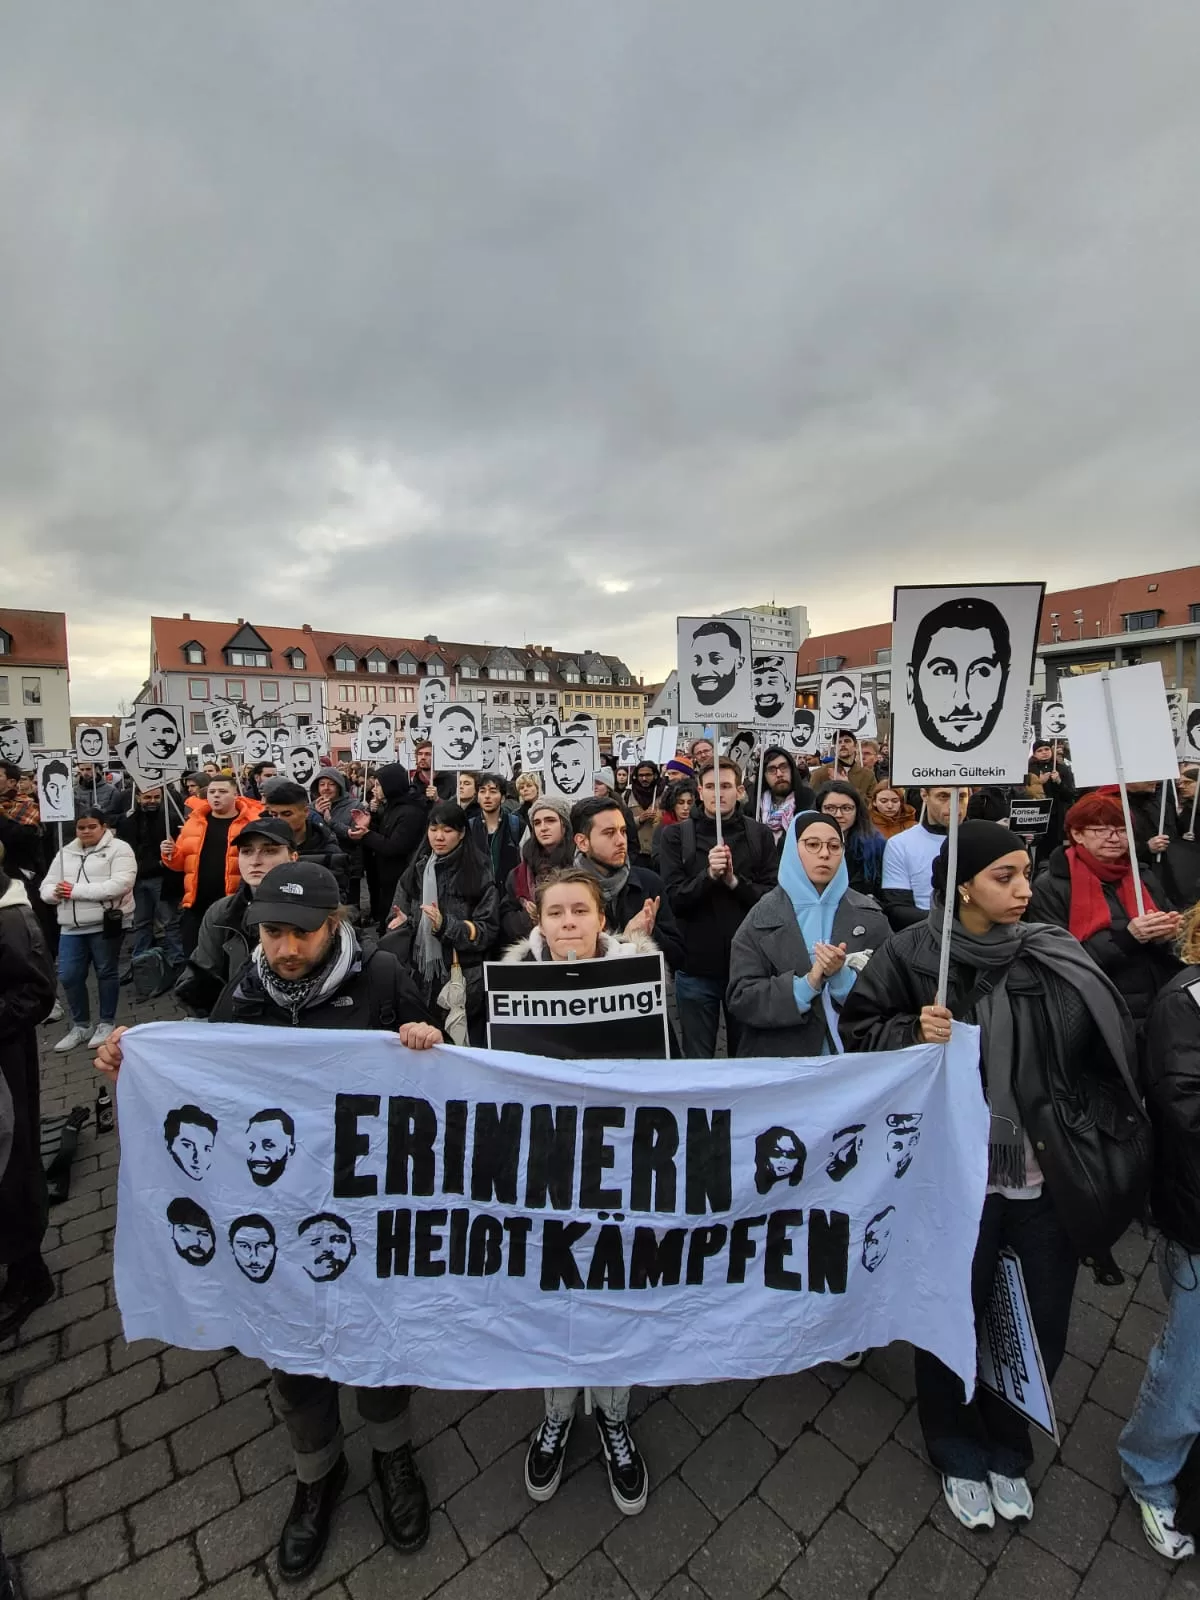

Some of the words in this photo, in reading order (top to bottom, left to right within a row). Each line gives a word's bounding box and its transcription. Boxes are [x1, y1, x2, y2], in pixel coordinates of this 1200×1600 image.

[694, 711, 714, 719] Sedat
[714, 711, 738, 719] Gürbüz
[912, 767, 956, 778] Gökhan
[959, 766, 1006, 777] Gültekin
[1012, 808, 1038, 816] Konse-
[1018, 814, 1049, 823] quenzen!
[492, 984, 663, 1016] Erinnerung!
[333, 1093, 733, 1216] ERINNERN
[540, 1209, 851, 1294] KÄMPFEN
[1006, 1264, 1016, 1289] Wir
